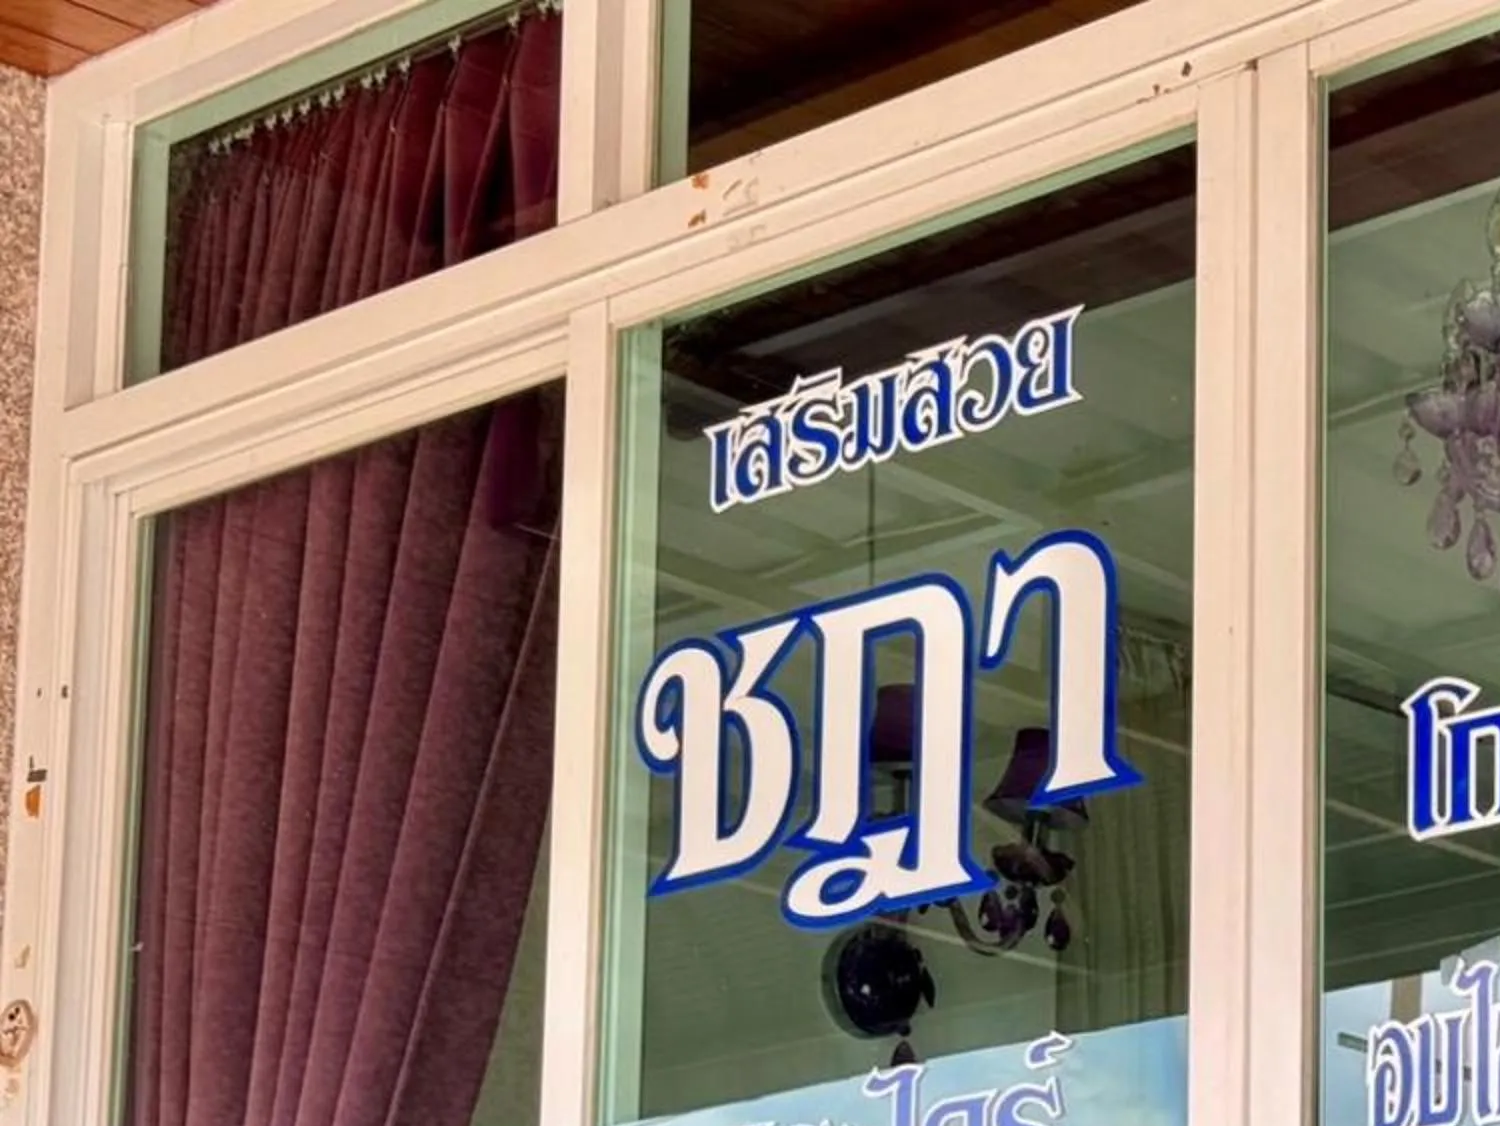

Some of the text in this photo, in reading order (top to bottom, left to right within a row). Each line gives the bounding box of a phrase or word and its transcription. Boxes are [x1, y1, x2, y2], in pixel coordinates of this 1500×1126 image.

[704, 303, 1085, 512] เสริมสวย
[636, 529, 1144, 929] ชฎา
